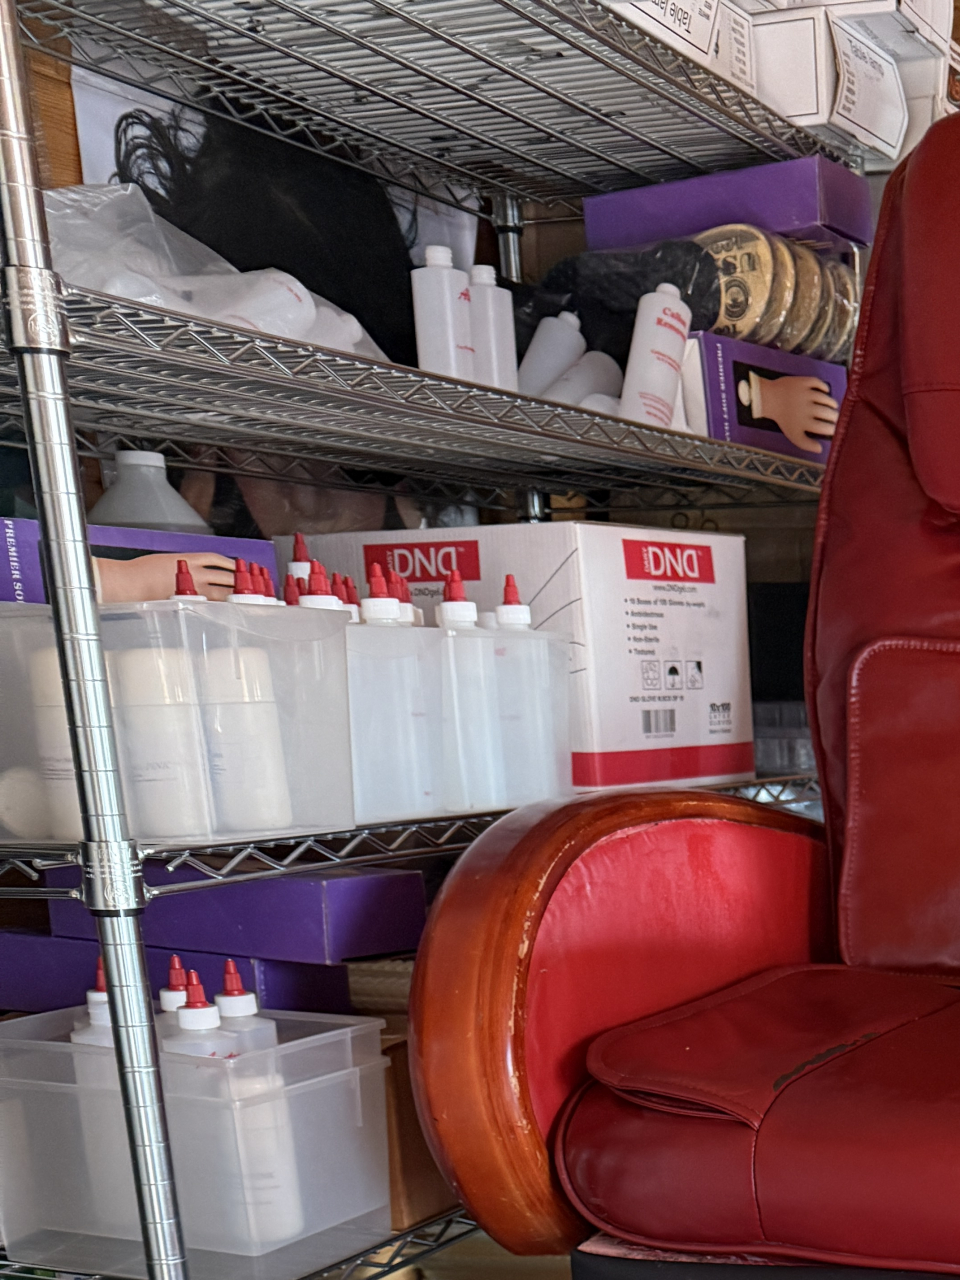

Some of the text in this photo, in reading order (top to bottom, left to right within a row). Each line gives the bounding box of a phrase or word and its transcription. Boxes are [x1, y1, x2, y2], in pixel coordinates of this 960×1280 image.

[4, 519, 22, 579] PREMIER
[393, 546, 458, 578] DND
[648, 546, 700, 578] DND
